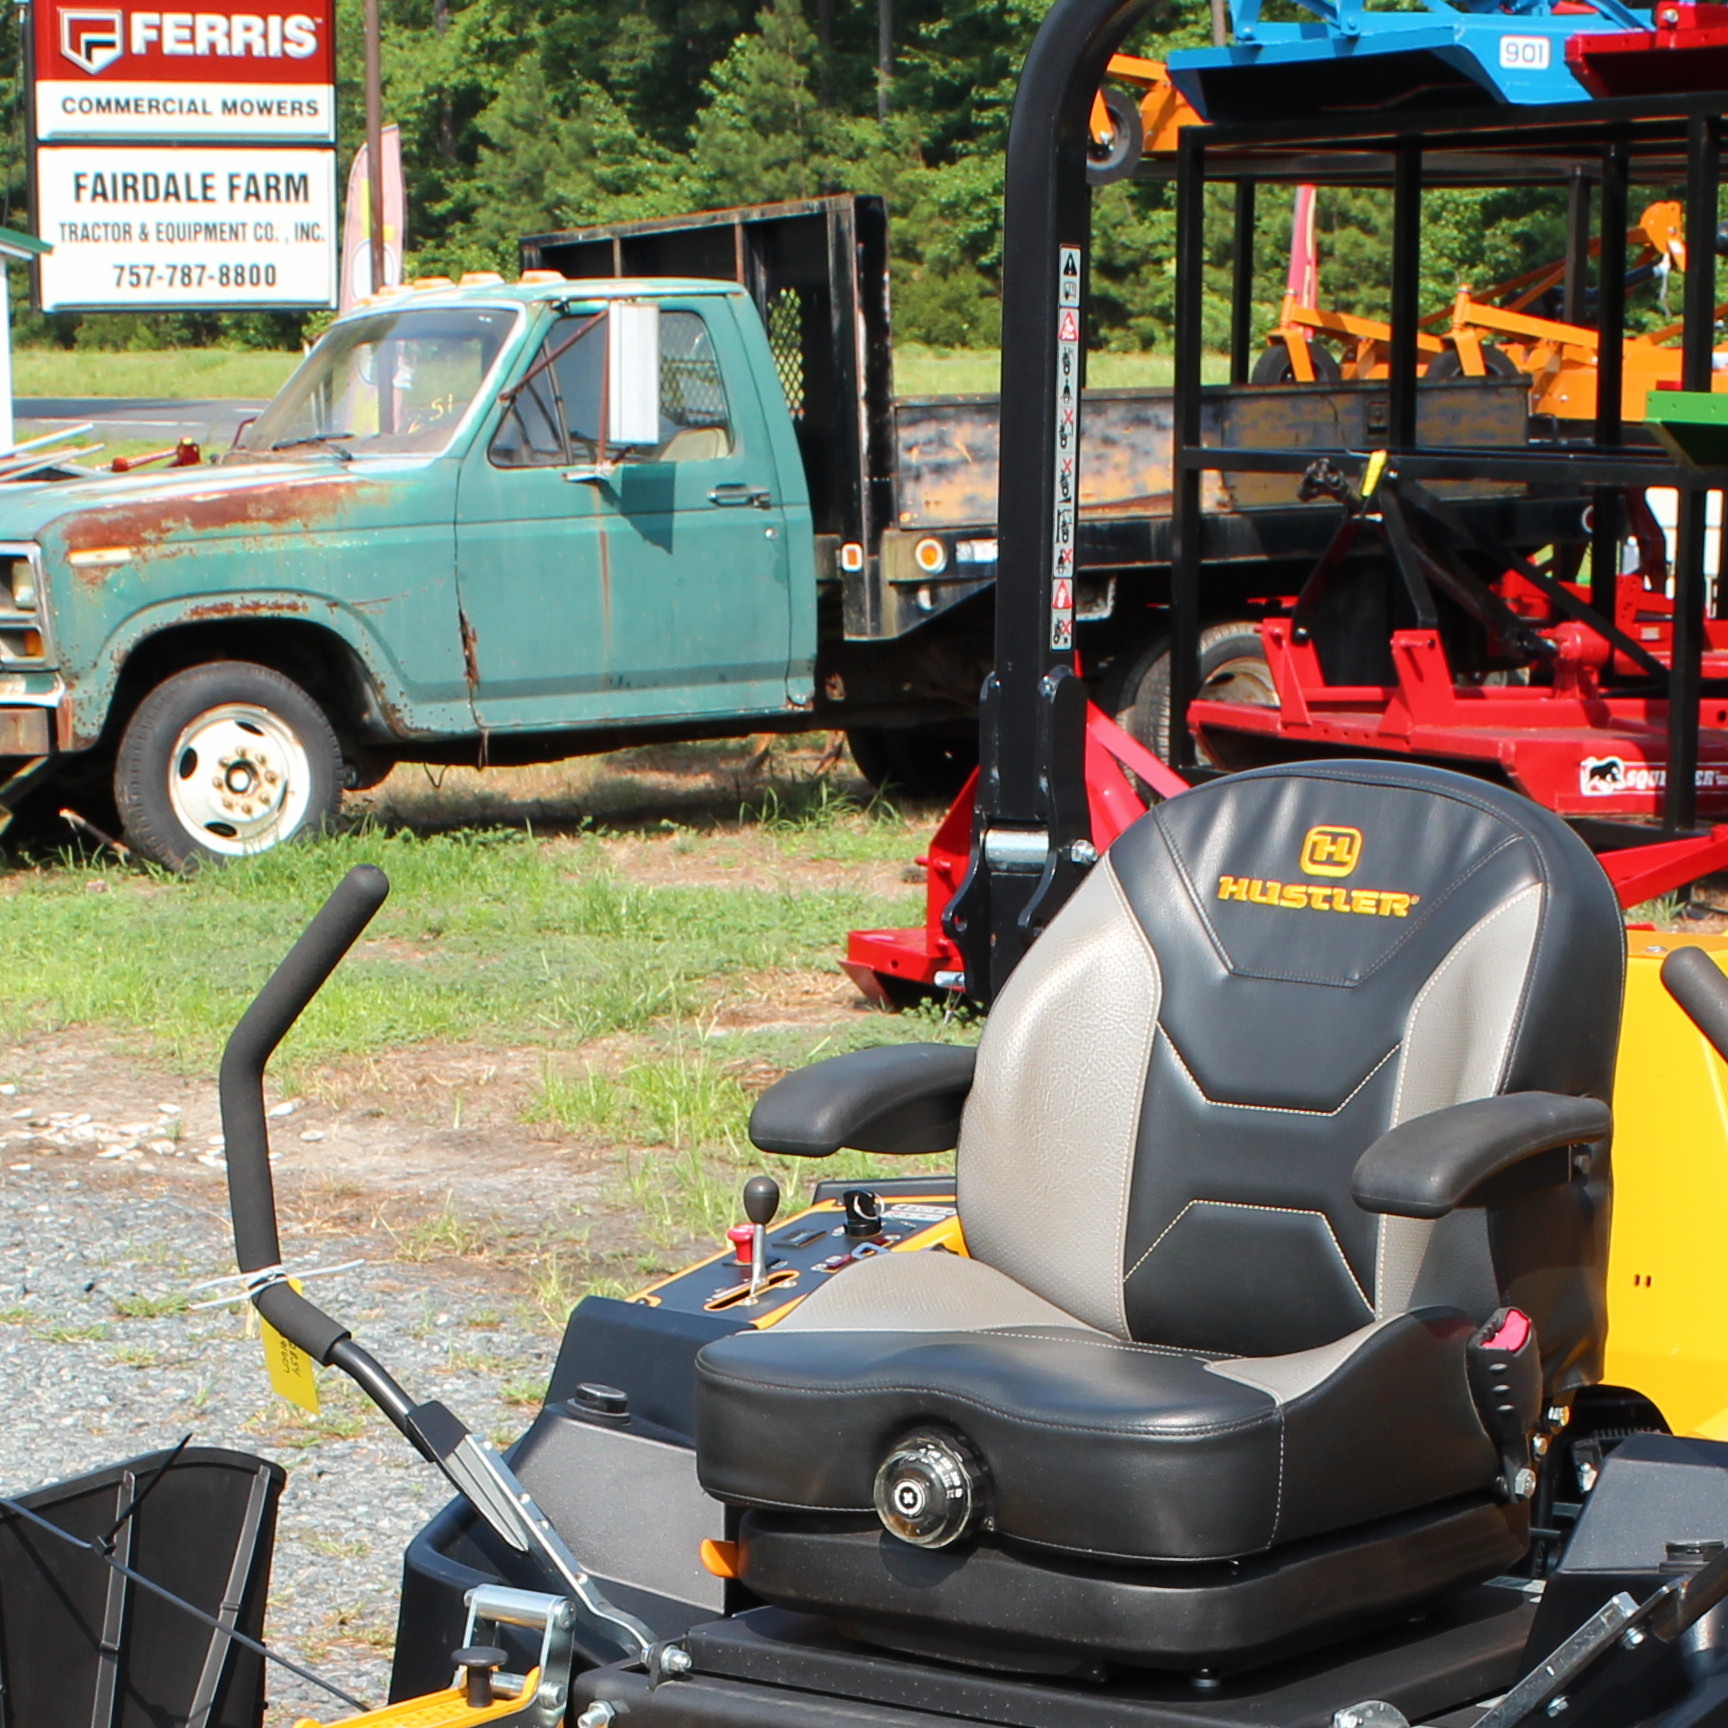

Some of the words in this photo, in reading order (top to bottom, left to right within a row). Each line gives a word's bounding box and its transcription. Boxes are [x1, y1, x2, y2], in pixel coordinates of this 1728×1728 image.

[130, 12, 318, 59] FERRIS
[1505, 42, 1544, 65] 901
[61, 97, 213, 116] COMMERCIAL
[221, 99, 320, 117] MOWERS
[73, 172, 217, 204] FAIRDALE
[227, 172, 310, 204] FARM
[58, 222, 133, 243] TRACTOR
[138, 222, 150, 243] &
[156, 222, 248, 243] EQUIPMENT
[293, 223, 326, 243] INC.
[112, 264, 277, 289] 757-787-8800
[1216, 875, 1410, 918] HUSTLER
